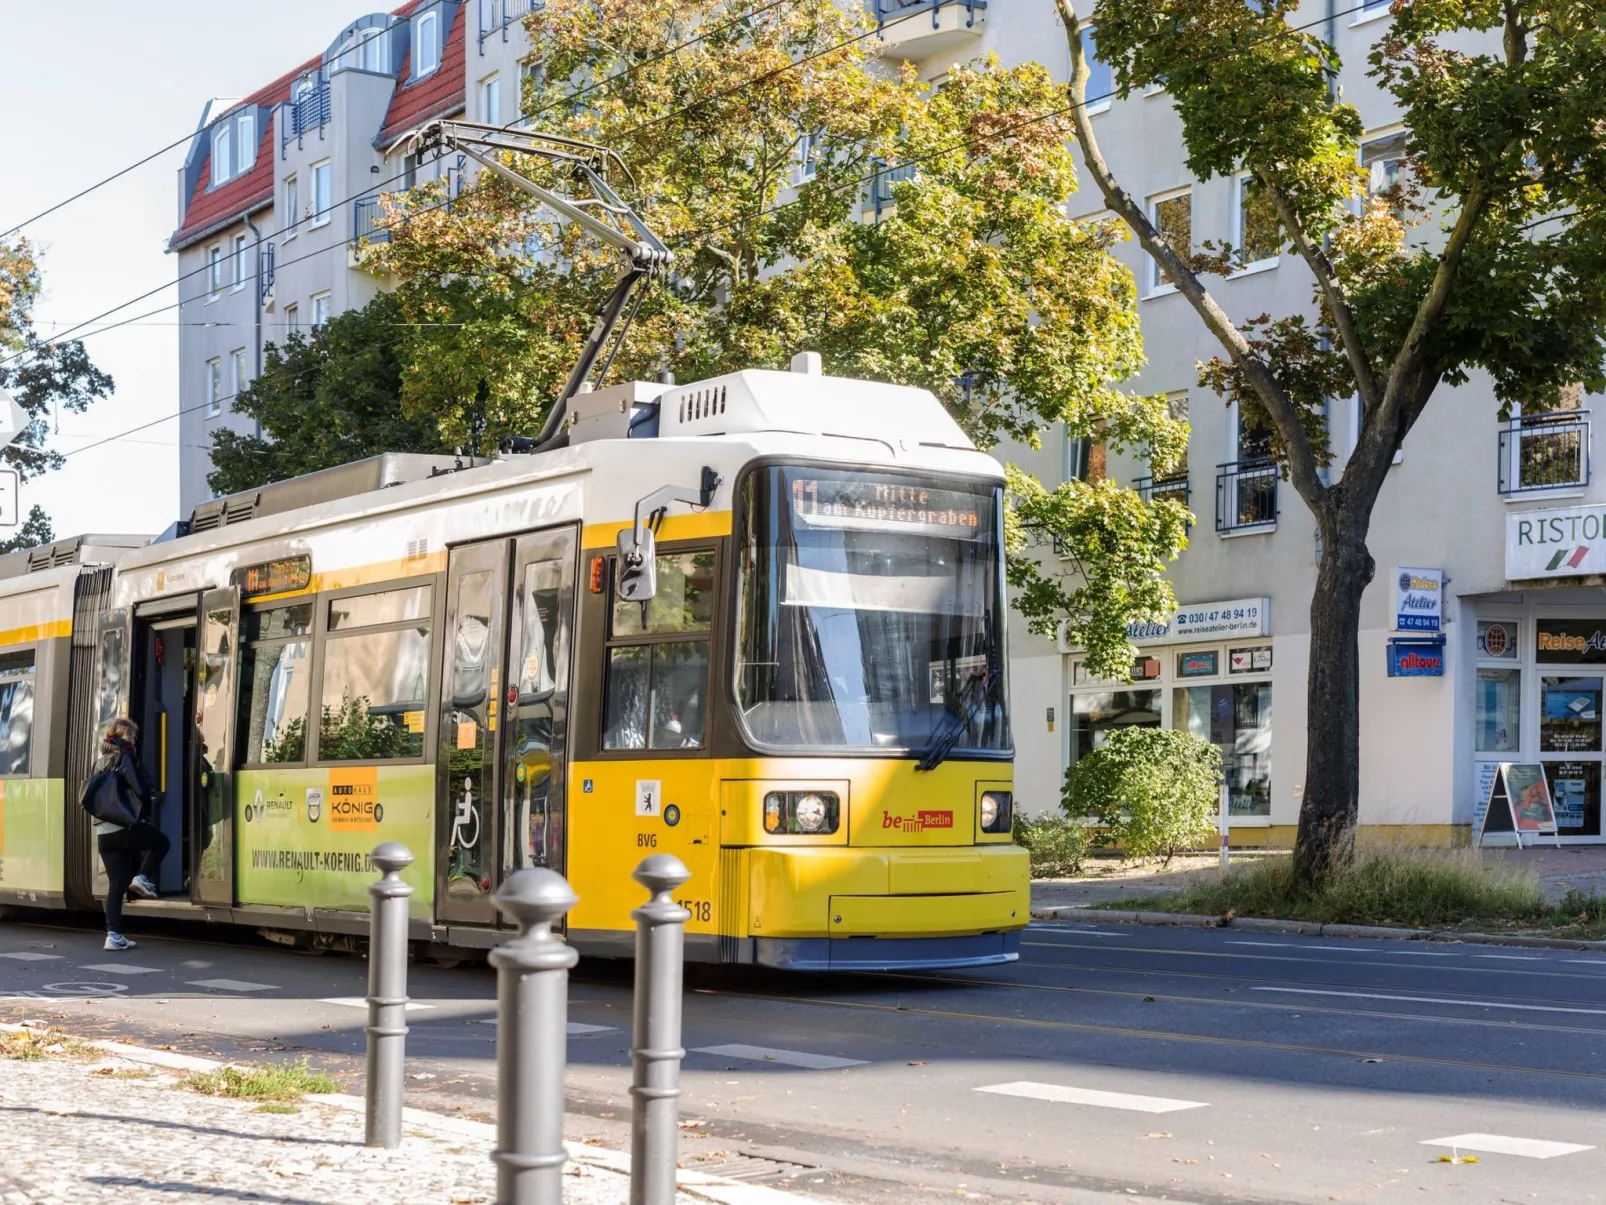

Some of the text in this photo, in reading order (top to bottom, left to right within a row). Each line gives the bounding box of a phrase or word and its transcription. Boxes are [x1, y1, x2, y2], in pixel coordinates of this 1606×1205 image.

[876, 485, 929, 504] Mitte
[1518, 514, 1606, 546] RISTO
[1410, 575, 1439, 592] Reise
[1401, 592, 1437, 611] Atelier
[1221, 610, 1232, 620] 48
[1233, 609, 1244, 619] 94
[1247, 607, 1258, 618] 19
[1125, 621, 1171, 639] Atelier
[1178, 621, 1258, 635] www.reiseatelier-berlin.de
[1406, 618, 1438, 627] 47 48 94 19
[1400, 653, 1440, 669] alltours
[266, 801, 293, 811] RENAULT
[332, 799, 373, 814] KÖNIG
[924, 814, 950, 825] Berlin
[637, 833, 657, 847] BVG
